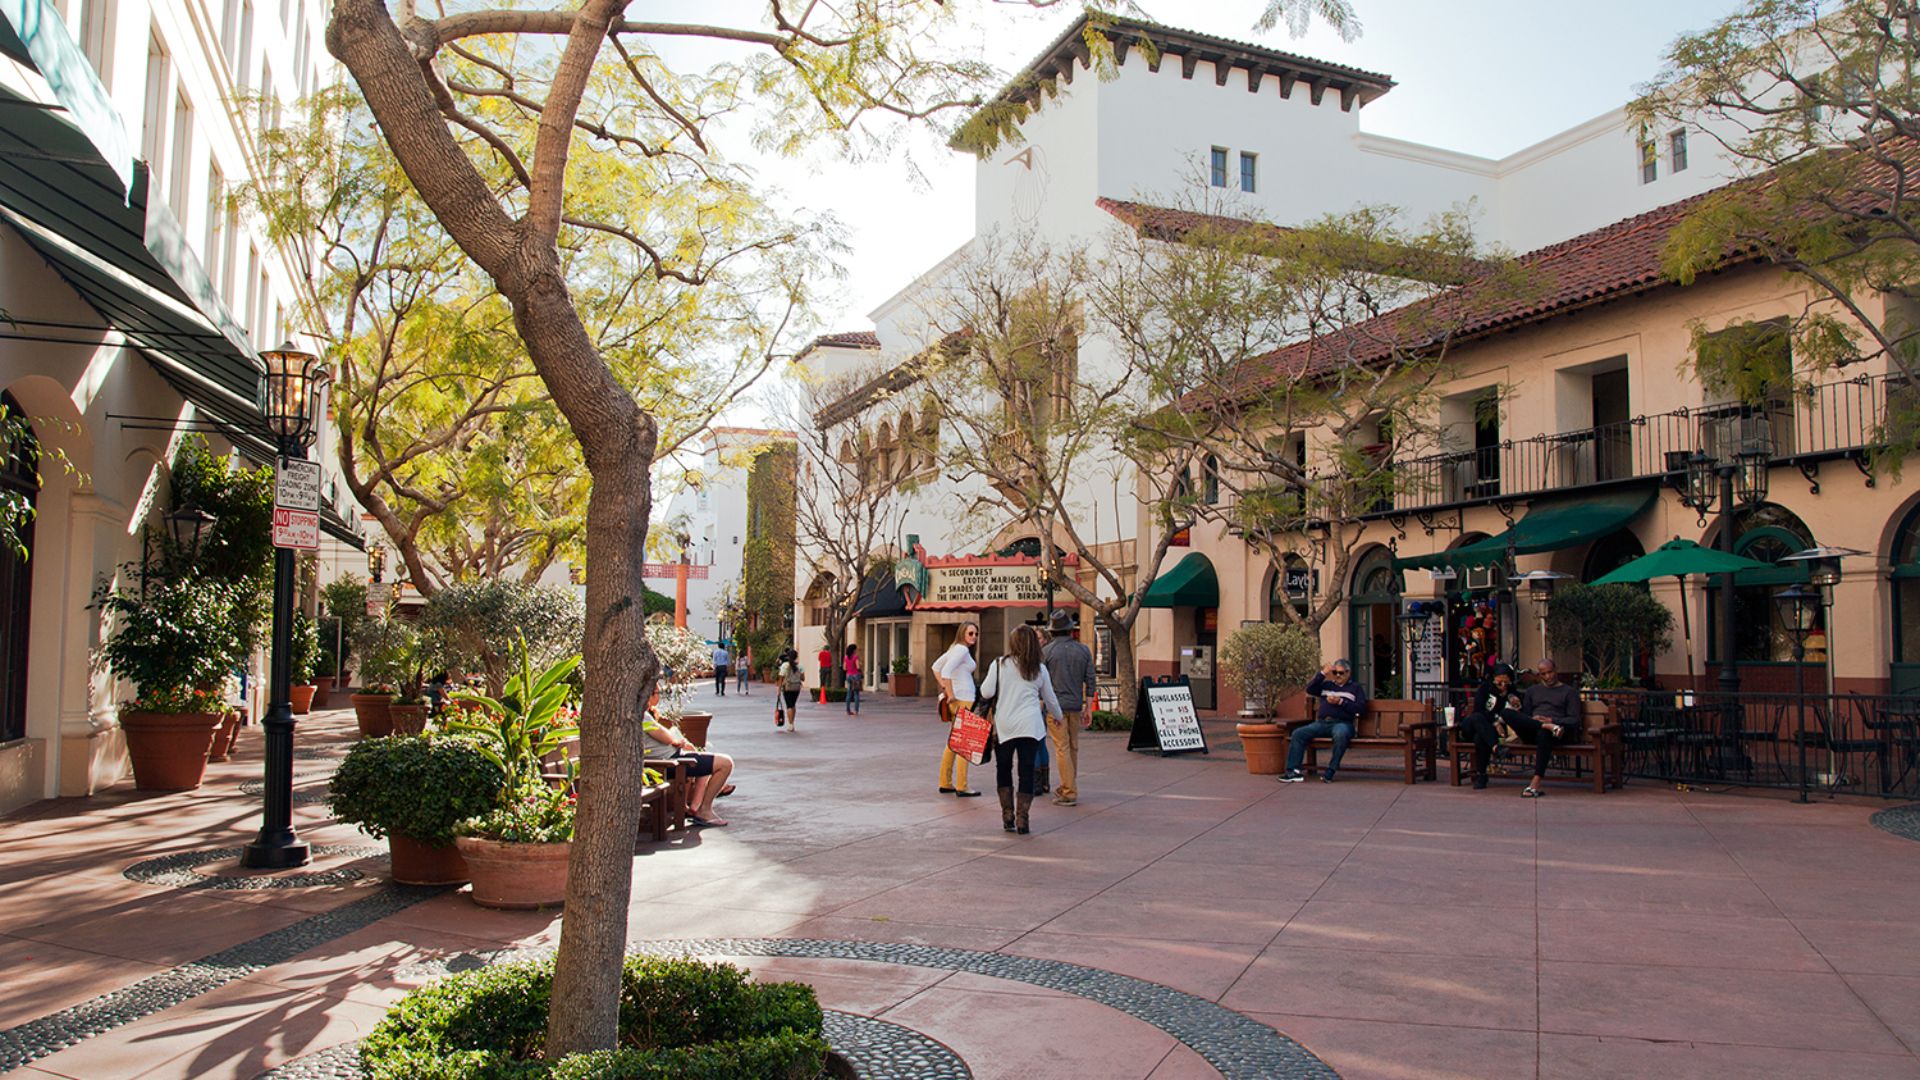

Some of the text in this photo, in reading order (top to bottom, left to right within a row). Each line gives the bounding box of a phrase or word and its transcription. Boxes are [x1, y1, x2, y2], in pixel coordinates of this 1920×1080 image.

[287, 471, 310, 481] FREIGHT
[279, 479, 318, 492] LOADING ZONE
[276, 510, 318, 527] NO STOPPING
[948, 569, 974, 577] SECOND
[975, 568, 993, 576] BEST
[963, 576, 1031, 584] EXOTIC MARIGOLD
[948, 585, 973, 593] SHADES
[975, 584, 985, 592] OF
[988, 584, 1008, 592] GREY
[1015, 583, 1038, 592] STILL
[937, 592, 1008, 601] THE IMITATION GAME
[1150, 693, 1191, 703] SUNGLASSES
[1178, 705, 1189, 713] $15
[1161, 717, 1166, 725] 2
[1180, 715, 1193, 723] $25
[1159, 727, 1200, 737] CELL PHONE
[1163, 737, 1200, 748] ACCESSORY
